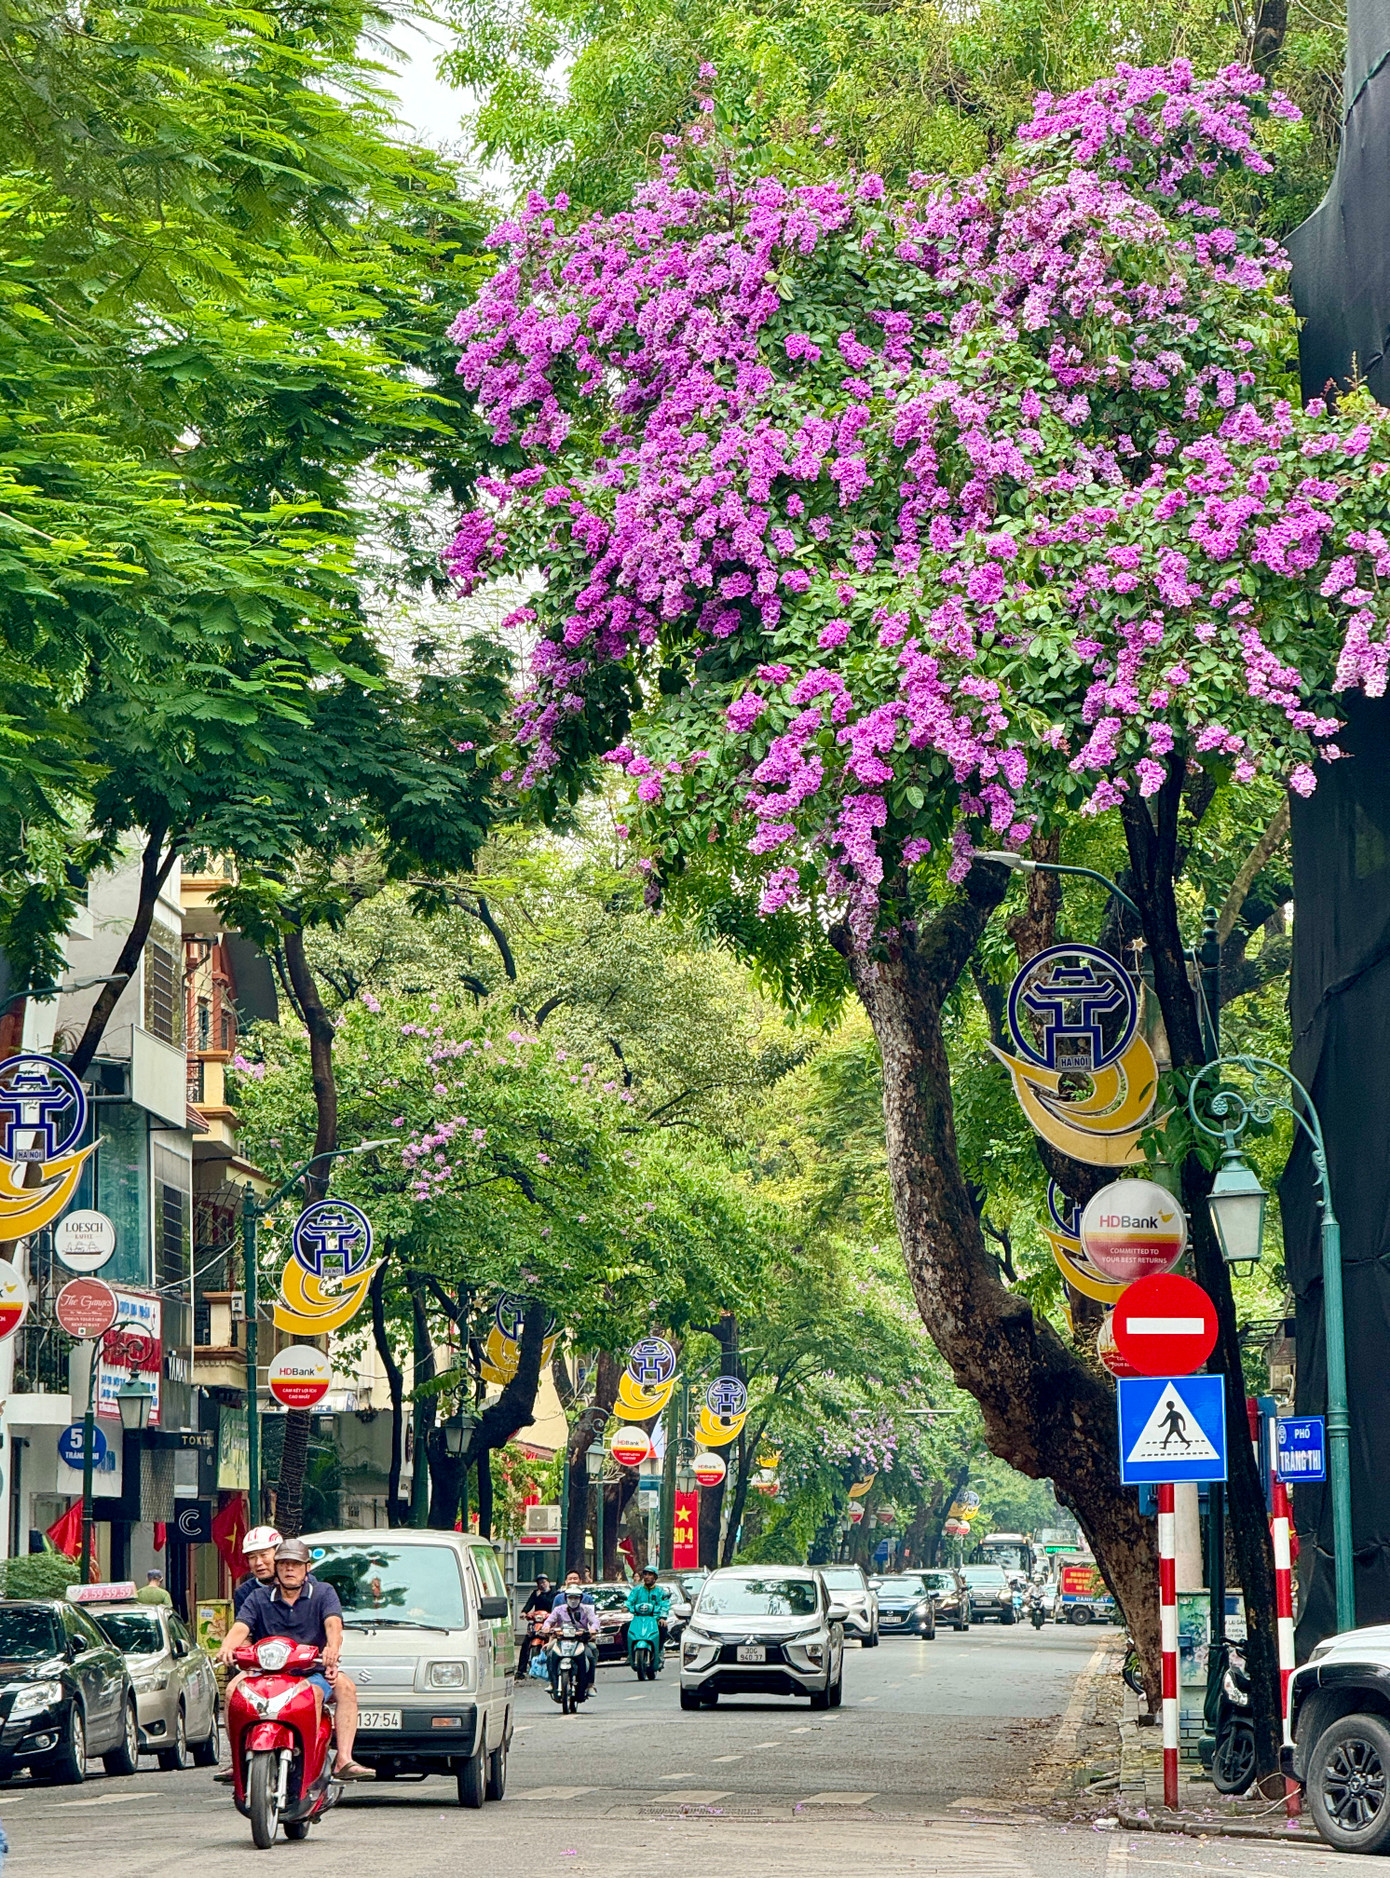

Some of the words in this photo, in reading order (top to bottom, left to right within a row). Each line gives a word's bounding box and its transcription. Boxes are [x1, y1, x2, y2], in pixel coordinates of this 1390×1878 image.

[65, 1222, 103, 1233] LOESCH
[1099, 1215, 1158, 1229] HDBank
[60, 1294, 78, 1307] The
[80, 1295, 112, 1310] Ganges
[279, 1367, 315, 1376] HDBank
[1294, 1424, 1311, 1439] PHỐ
[1280, 1445, 1307, 1472] TRÀNG
[1307, 1449, 1321, 1471] THI
[673, 1527, 694, 1543] 30-4
